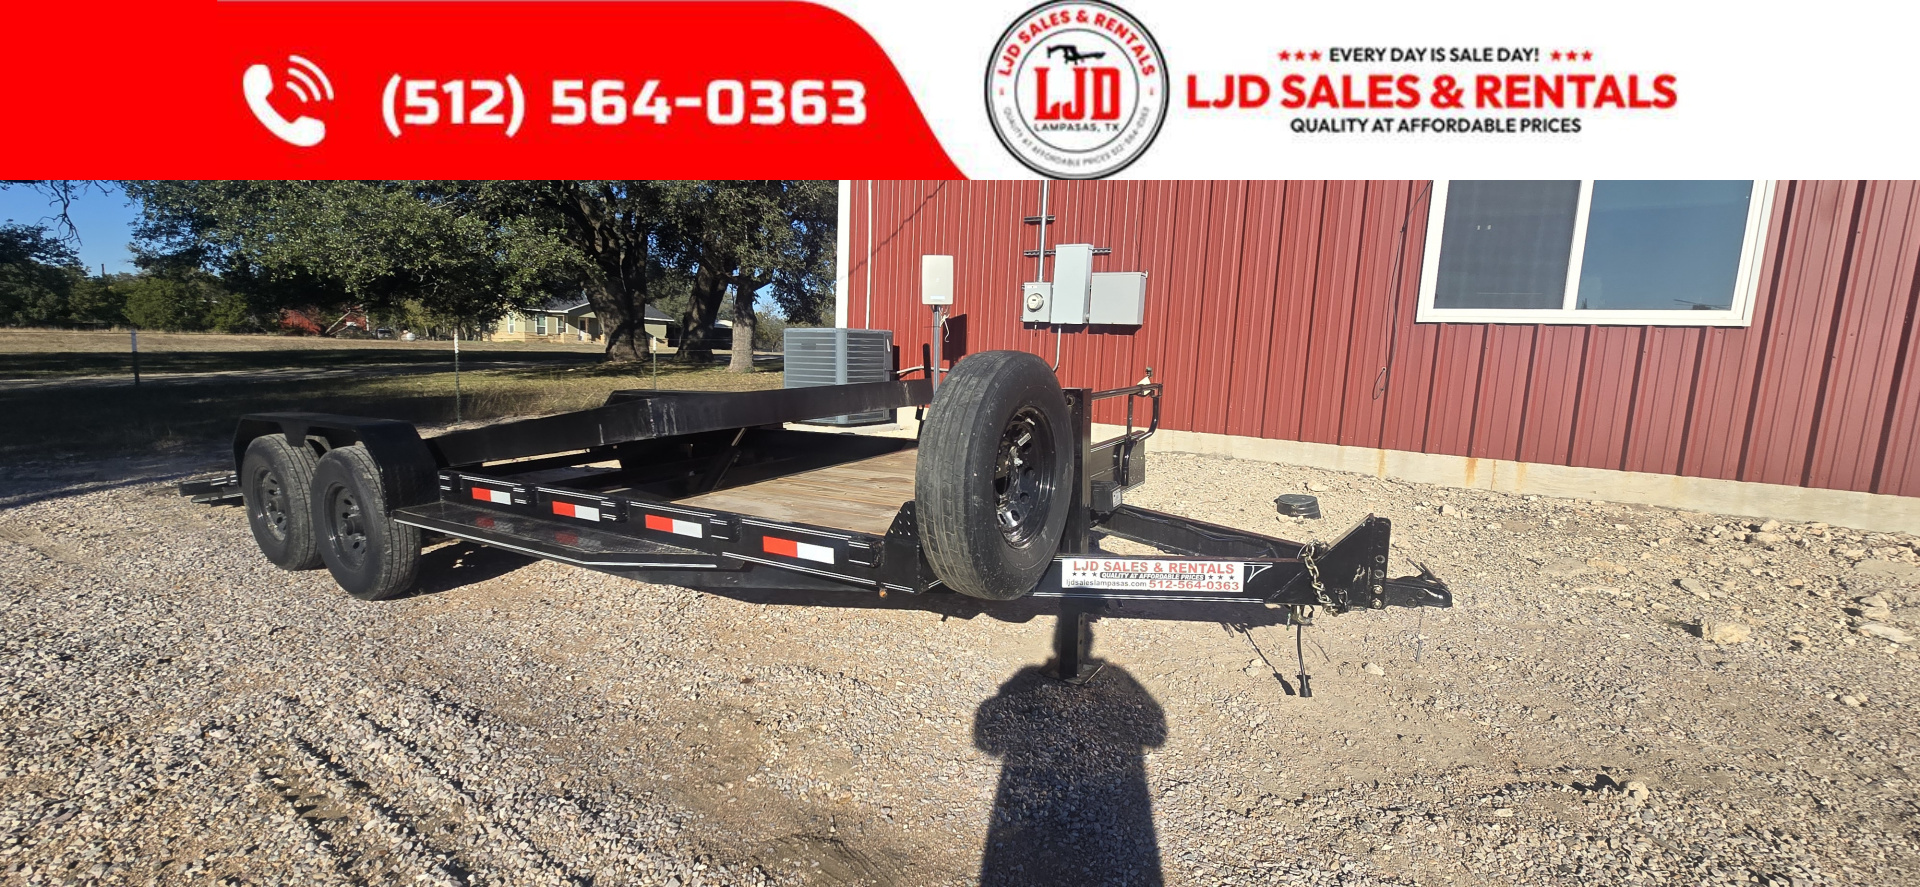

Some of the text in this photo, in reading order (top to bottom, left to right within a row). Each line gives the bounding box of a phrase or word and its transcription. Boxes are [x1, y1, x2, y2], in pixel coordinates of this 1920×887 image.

[1073, 561, 1235, 574] LJD SALES & RENTALS
[1066, 579, 1240, 591] ljdsaleslampasas.com 512-564-0363
